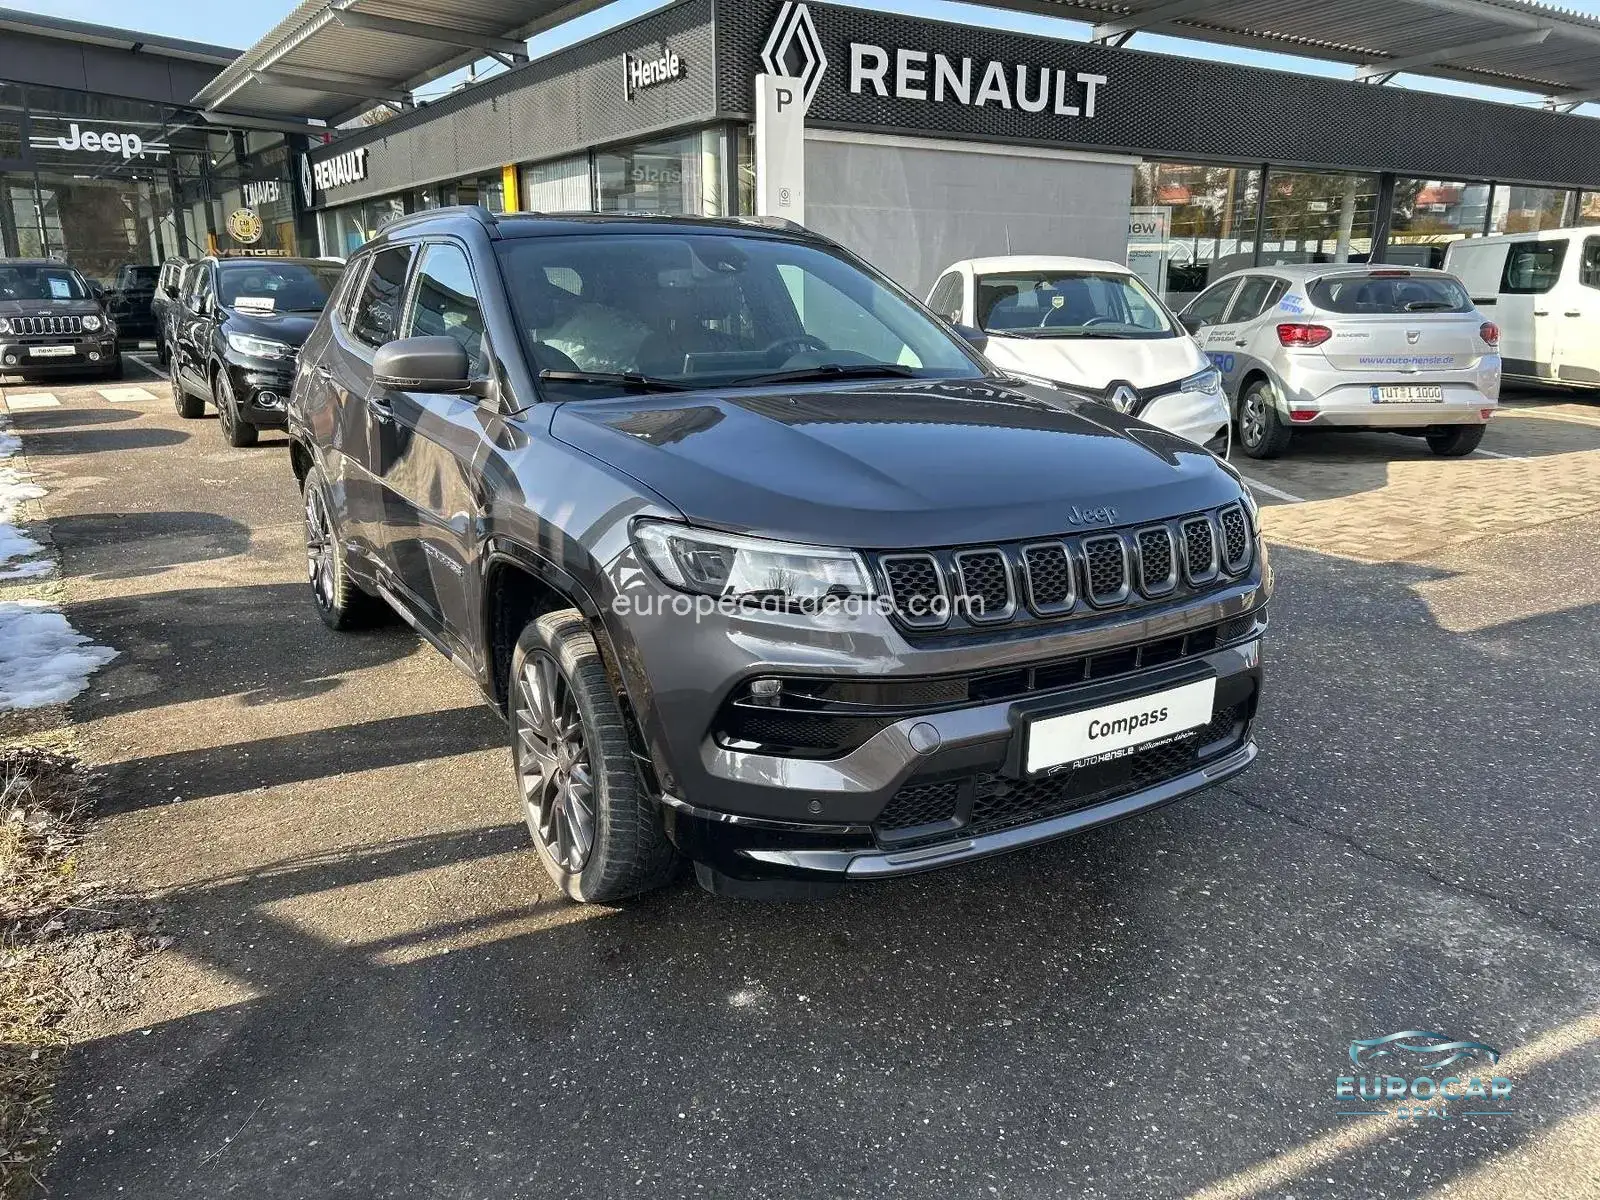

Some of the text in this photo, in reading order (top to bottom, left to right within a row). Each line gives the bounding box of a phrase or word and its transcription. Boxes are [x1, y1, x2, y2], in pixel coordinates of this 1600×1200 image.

[631, 48, 680, 88] Hensle
[850, 43, 1107, 117] RENAULT
[776, 88, 793, 112] P
[58, 124, 145, 158] Jeep
[313, 148, 364, 190] RENAULT
[1360, 355, 1455, 365] www.auto-hensle.de
[1380, 387, 1398, 398] TUT
[1416, 387, 1441, 398] 1000
[1068, 505, 1117, 525] Jeep
[1088, 707, 1168, 740] Compass
